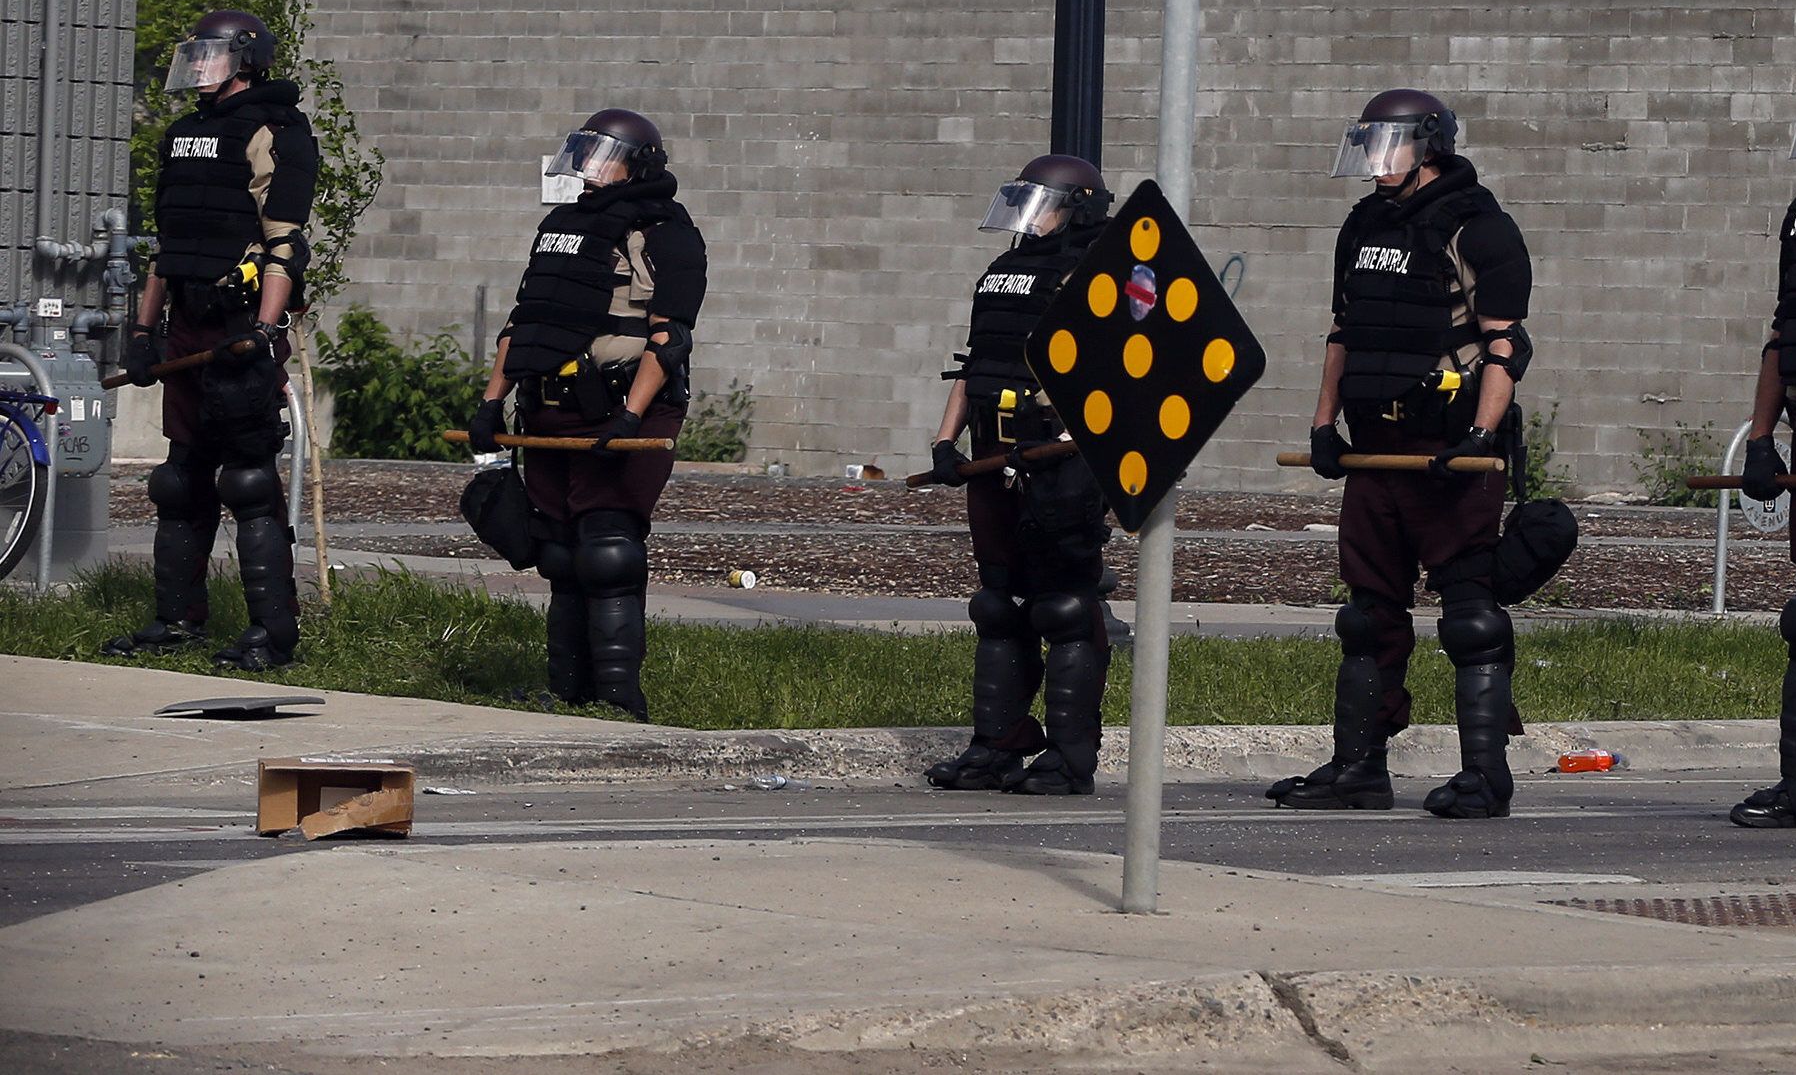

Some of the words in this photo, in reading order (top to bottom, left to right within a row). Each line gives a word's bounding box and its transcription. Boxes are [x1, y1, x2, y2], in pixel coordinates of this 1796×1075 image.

[171, 137, 193, 158] STATE
[190, 137, 218, 158] PATROL
[979, 274, 1008, 293] STATE
[1000, 274, 1036, 294] PATROL
[57, 436, 90, 454] ACAB
